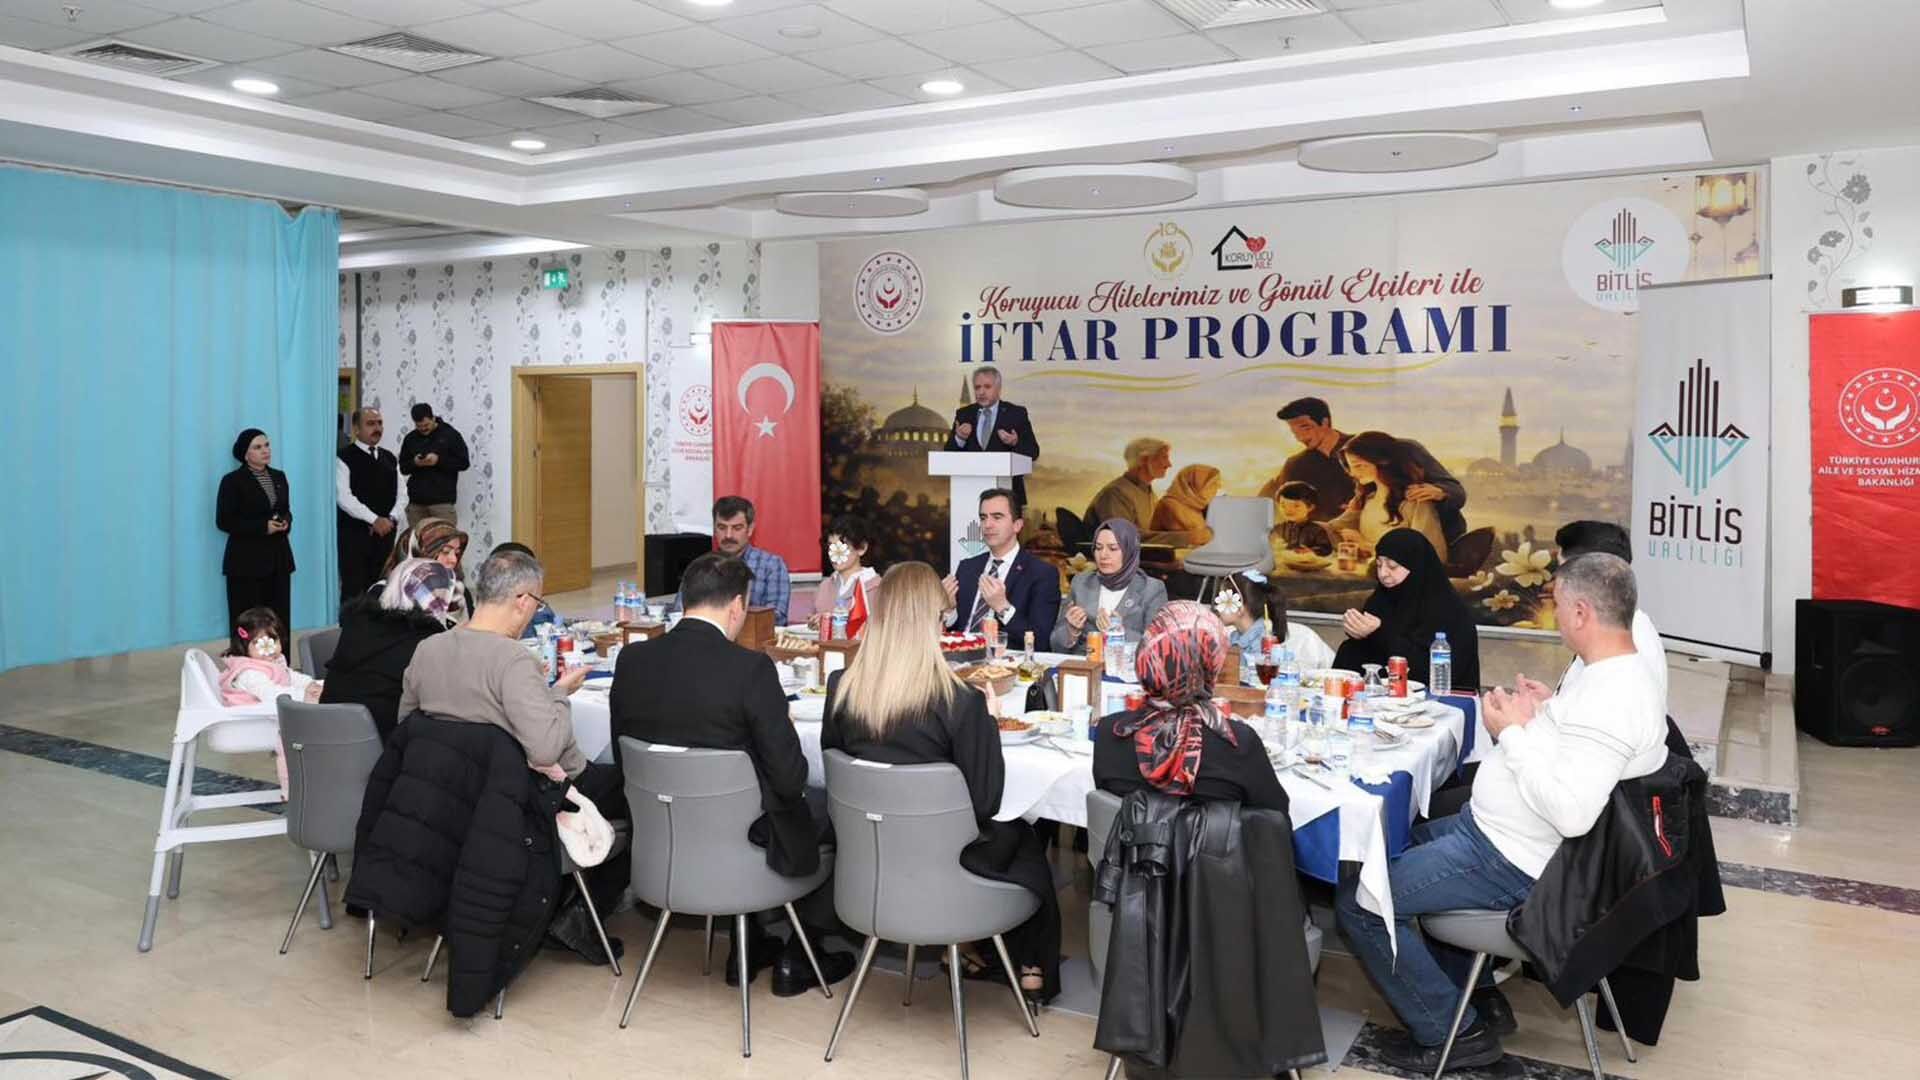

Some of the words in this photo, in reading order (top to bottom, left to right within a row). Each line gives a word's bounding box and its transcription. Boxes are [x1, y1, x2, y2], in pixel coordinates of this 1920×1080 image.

[1225, 251, 1273, 263] KORUYUCU
[1597, 269, 1653, 291] BİTLİS
[977, 285, 1081, 320] Koruyucu
[1087, 280, 1222, 313] Ailelerimiz
[1229, 286, 1251, 304] ve
[1258, 272, 1334, 312] Gönül
[1340, 267, 1445, 303] Elçileri
[1449, 267, 1485, 295] ile
[959, 312, 1120, 363] İFTAR
[1142, 304, 1513, 361] PROGRAMI
[1828, 455, 1871, 465] TÜRKİYE
[1873, 456, 1920, 465] CUMHUR
[1818, 465, 1840, 475] AİLE
[1841, 467, 1854, 475] VE
[1856, 467, 1895, 476] SOSYAL
[1858, 477, 1914, 487] BAKANLIĞI
[1649, 495, 1743, 544] BİTLİS
